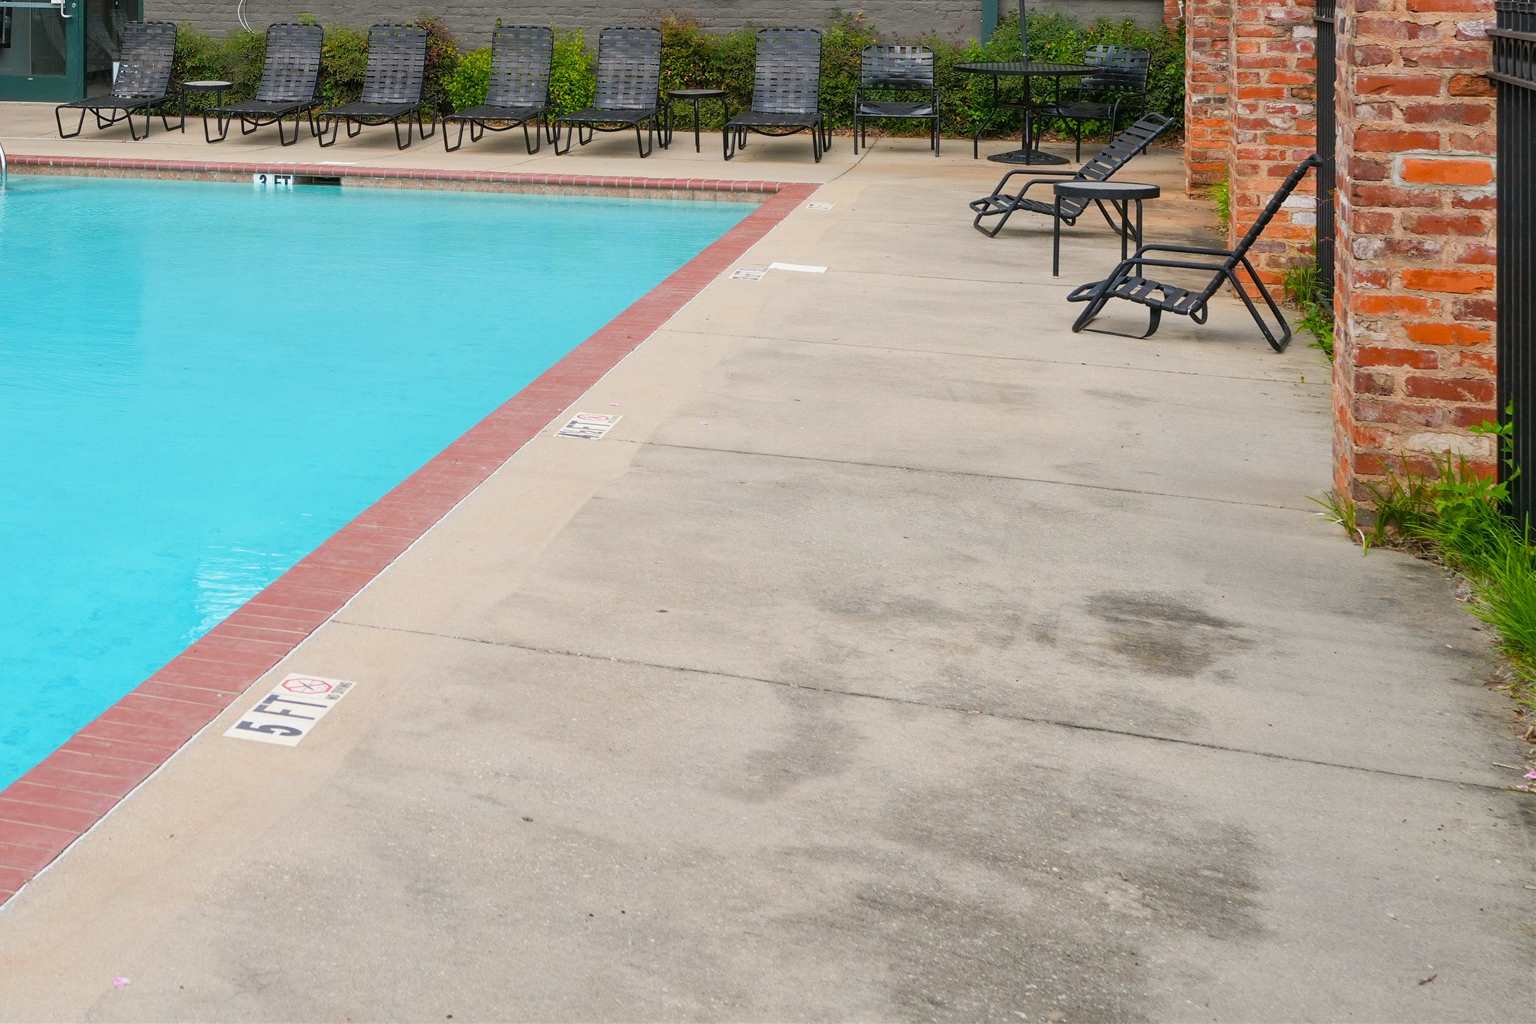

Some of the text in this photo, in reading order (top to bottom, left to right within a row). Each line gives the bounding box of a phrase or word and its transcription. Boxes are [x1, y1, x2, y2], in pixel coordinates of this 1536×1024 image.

[274, 174, 291, 185] FT
[236, 693, 329, 737] 5 FT
